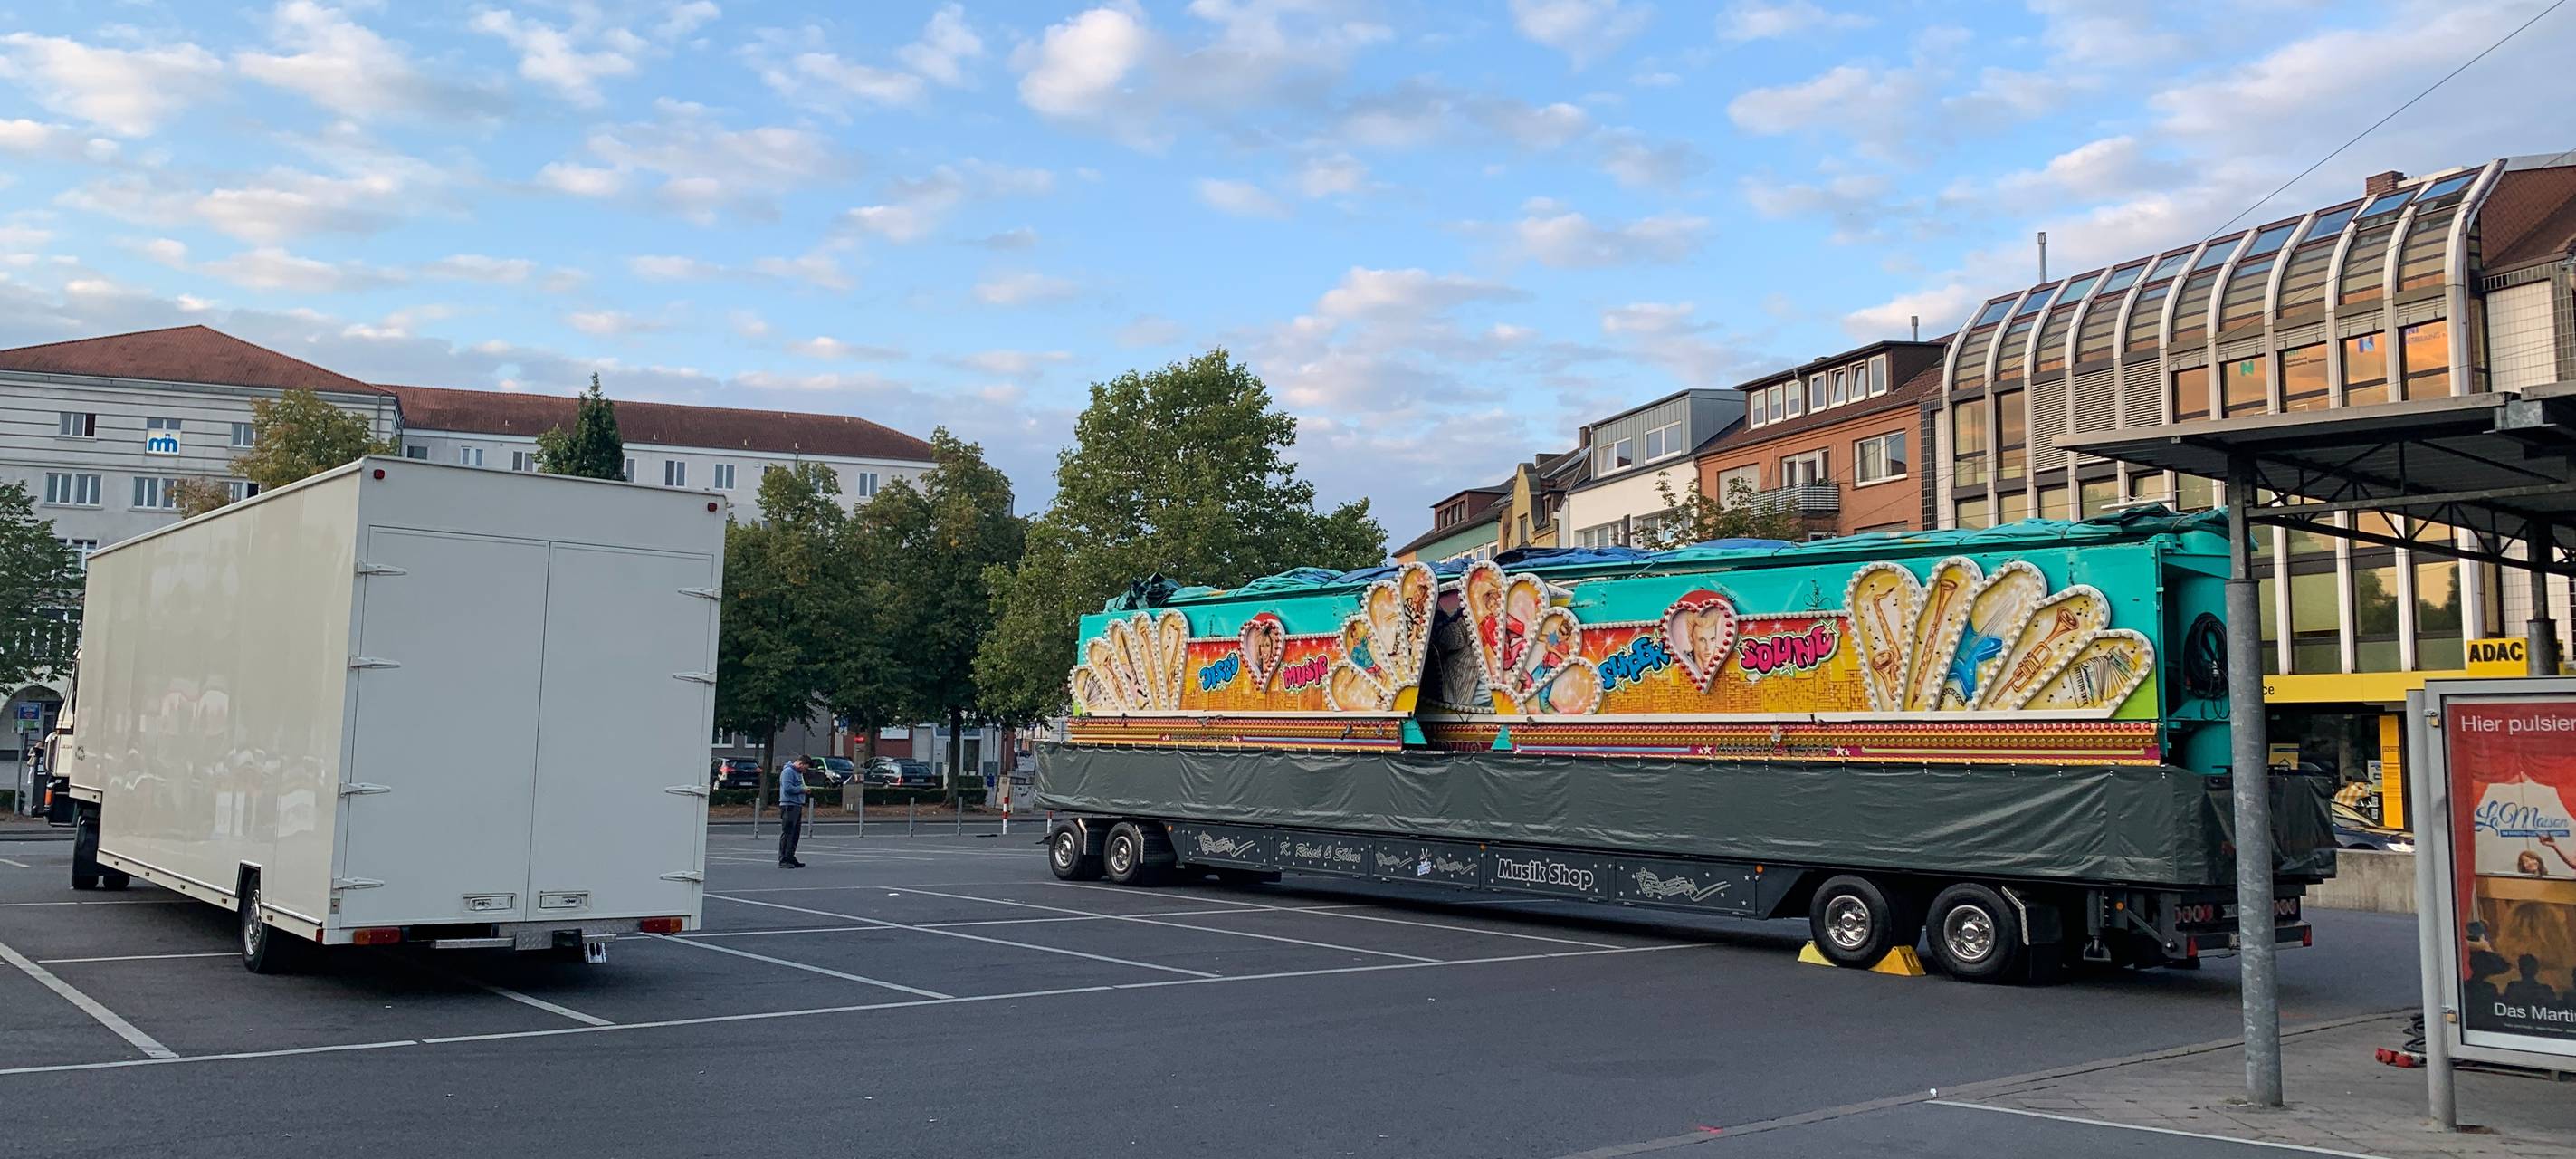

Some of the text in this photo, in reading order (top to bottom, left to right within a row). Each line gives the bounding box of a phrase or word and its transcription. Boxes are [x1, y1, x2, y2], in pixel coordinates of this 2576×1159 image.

[1598, 625, 1836, 690] SUPER SOUND
[2469, 642, 2524, 662] ADAC
[1199, 652, 1329, 691] DISCO MUSIC
[2461, 715, 2503, 732] Hier
[2476, 800, 2569, 836] La Maison
[1498, 858, 1593, 890] Musik Shop
[2494, 1002, 2576, 1023] Das Marti
